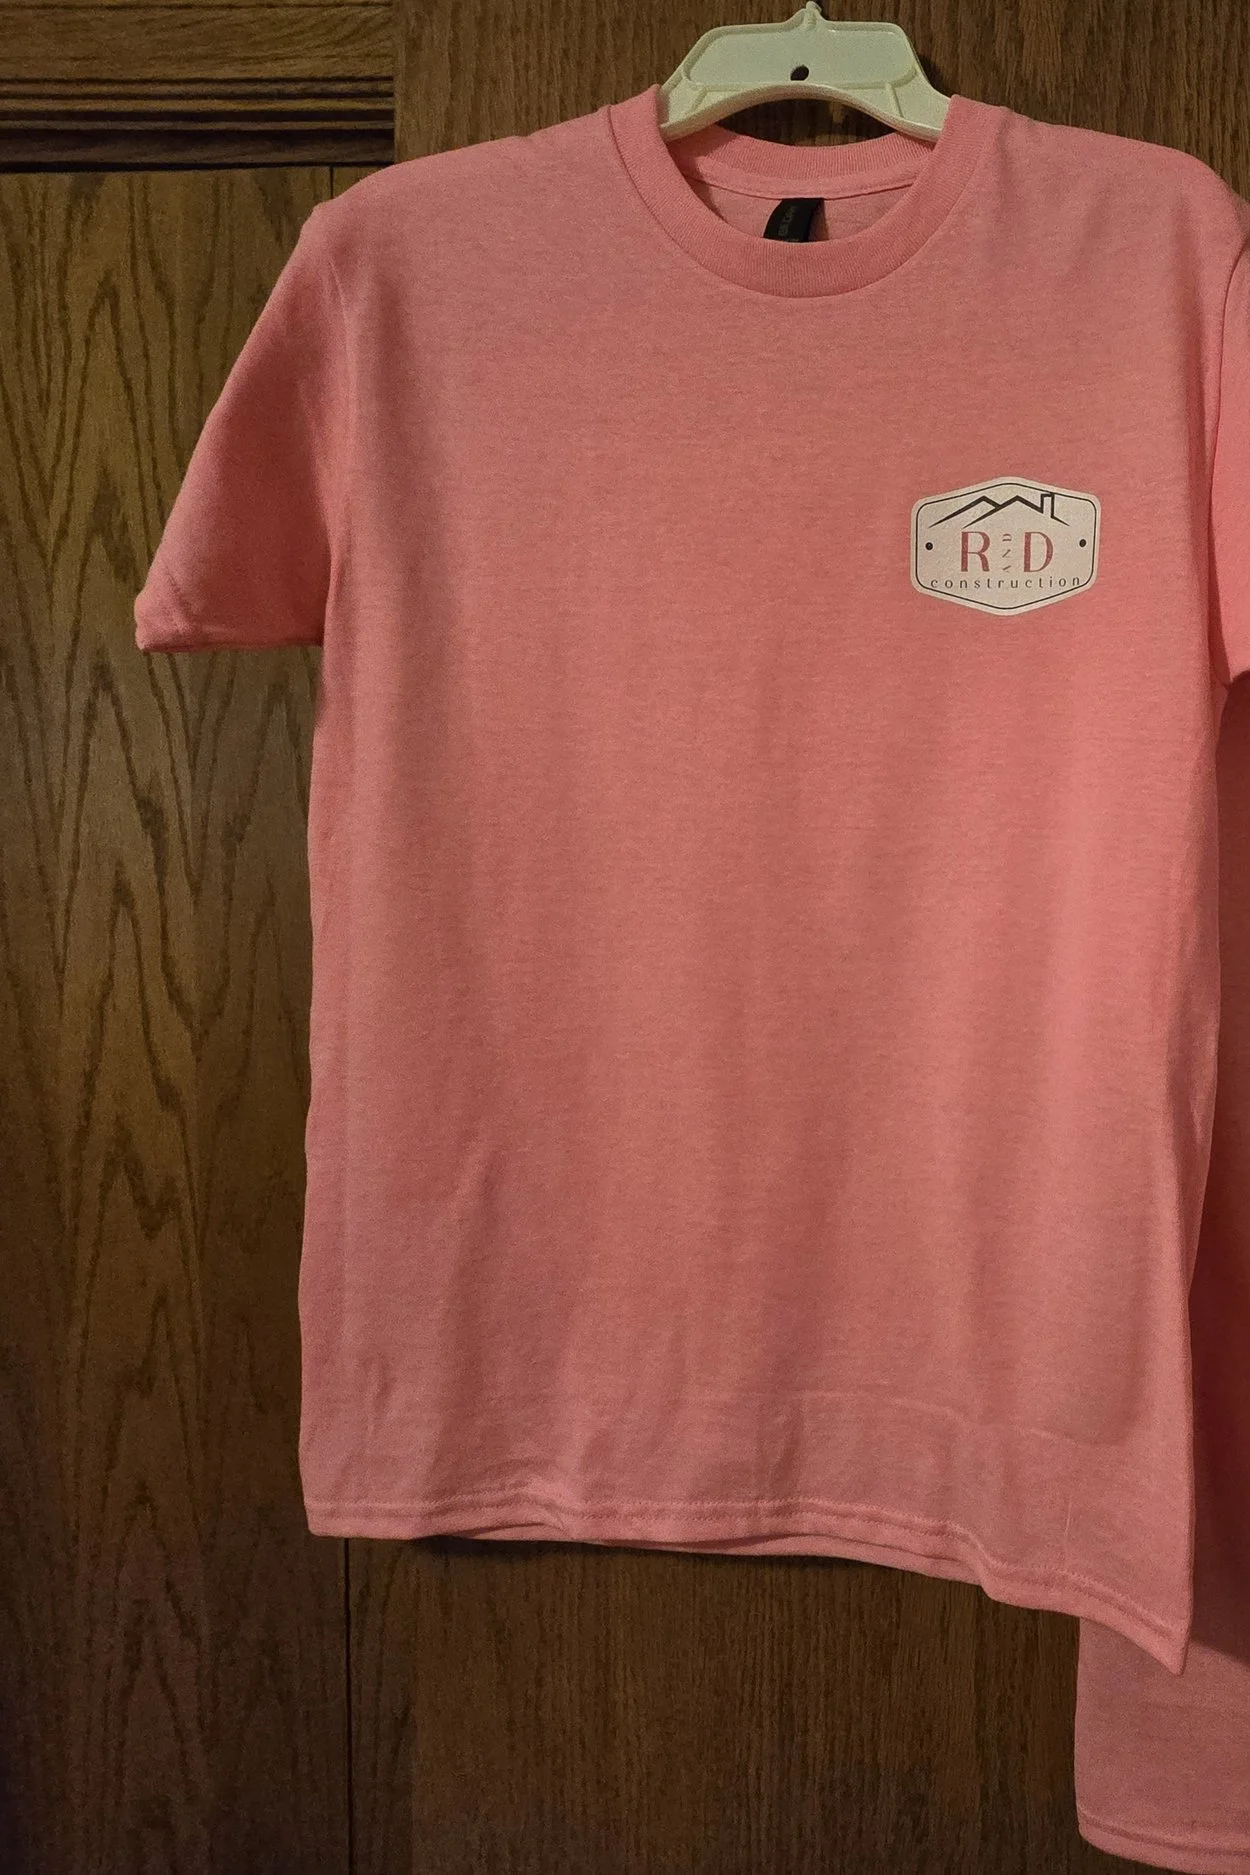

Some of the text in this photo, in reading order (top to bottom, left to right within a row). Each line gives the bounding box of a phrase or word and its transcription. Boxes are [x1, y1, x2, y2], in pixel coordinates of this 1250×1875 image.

[960, 531, 990, 572] R
[1023, 531, 1054, 572] D
[930, 576, 1080, 589] construction
